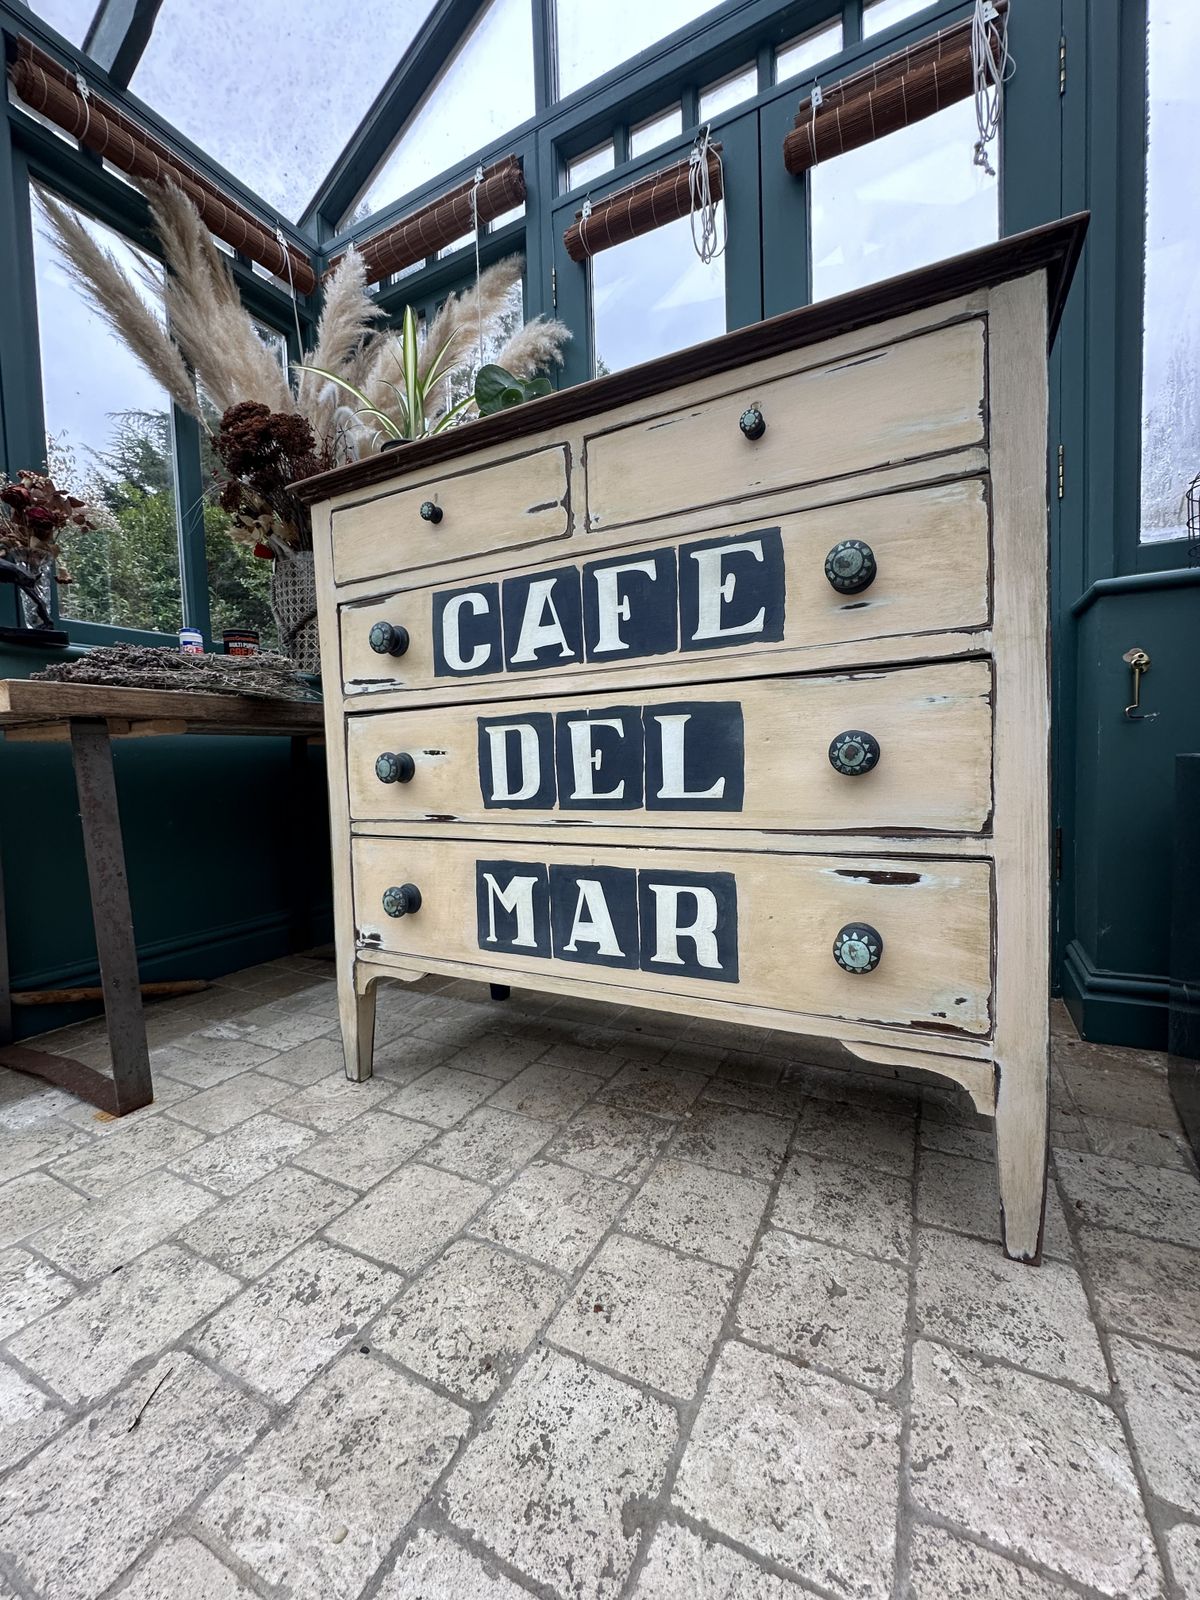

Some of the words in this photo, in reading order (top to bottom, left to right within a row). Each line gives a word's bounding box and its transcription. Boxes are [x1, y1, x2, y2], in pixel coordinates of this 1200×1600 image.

[442, 540, 766, 670] CAFE
[485, 714, 725, 801] DEL
[483, 872, 723, 969] MAR
